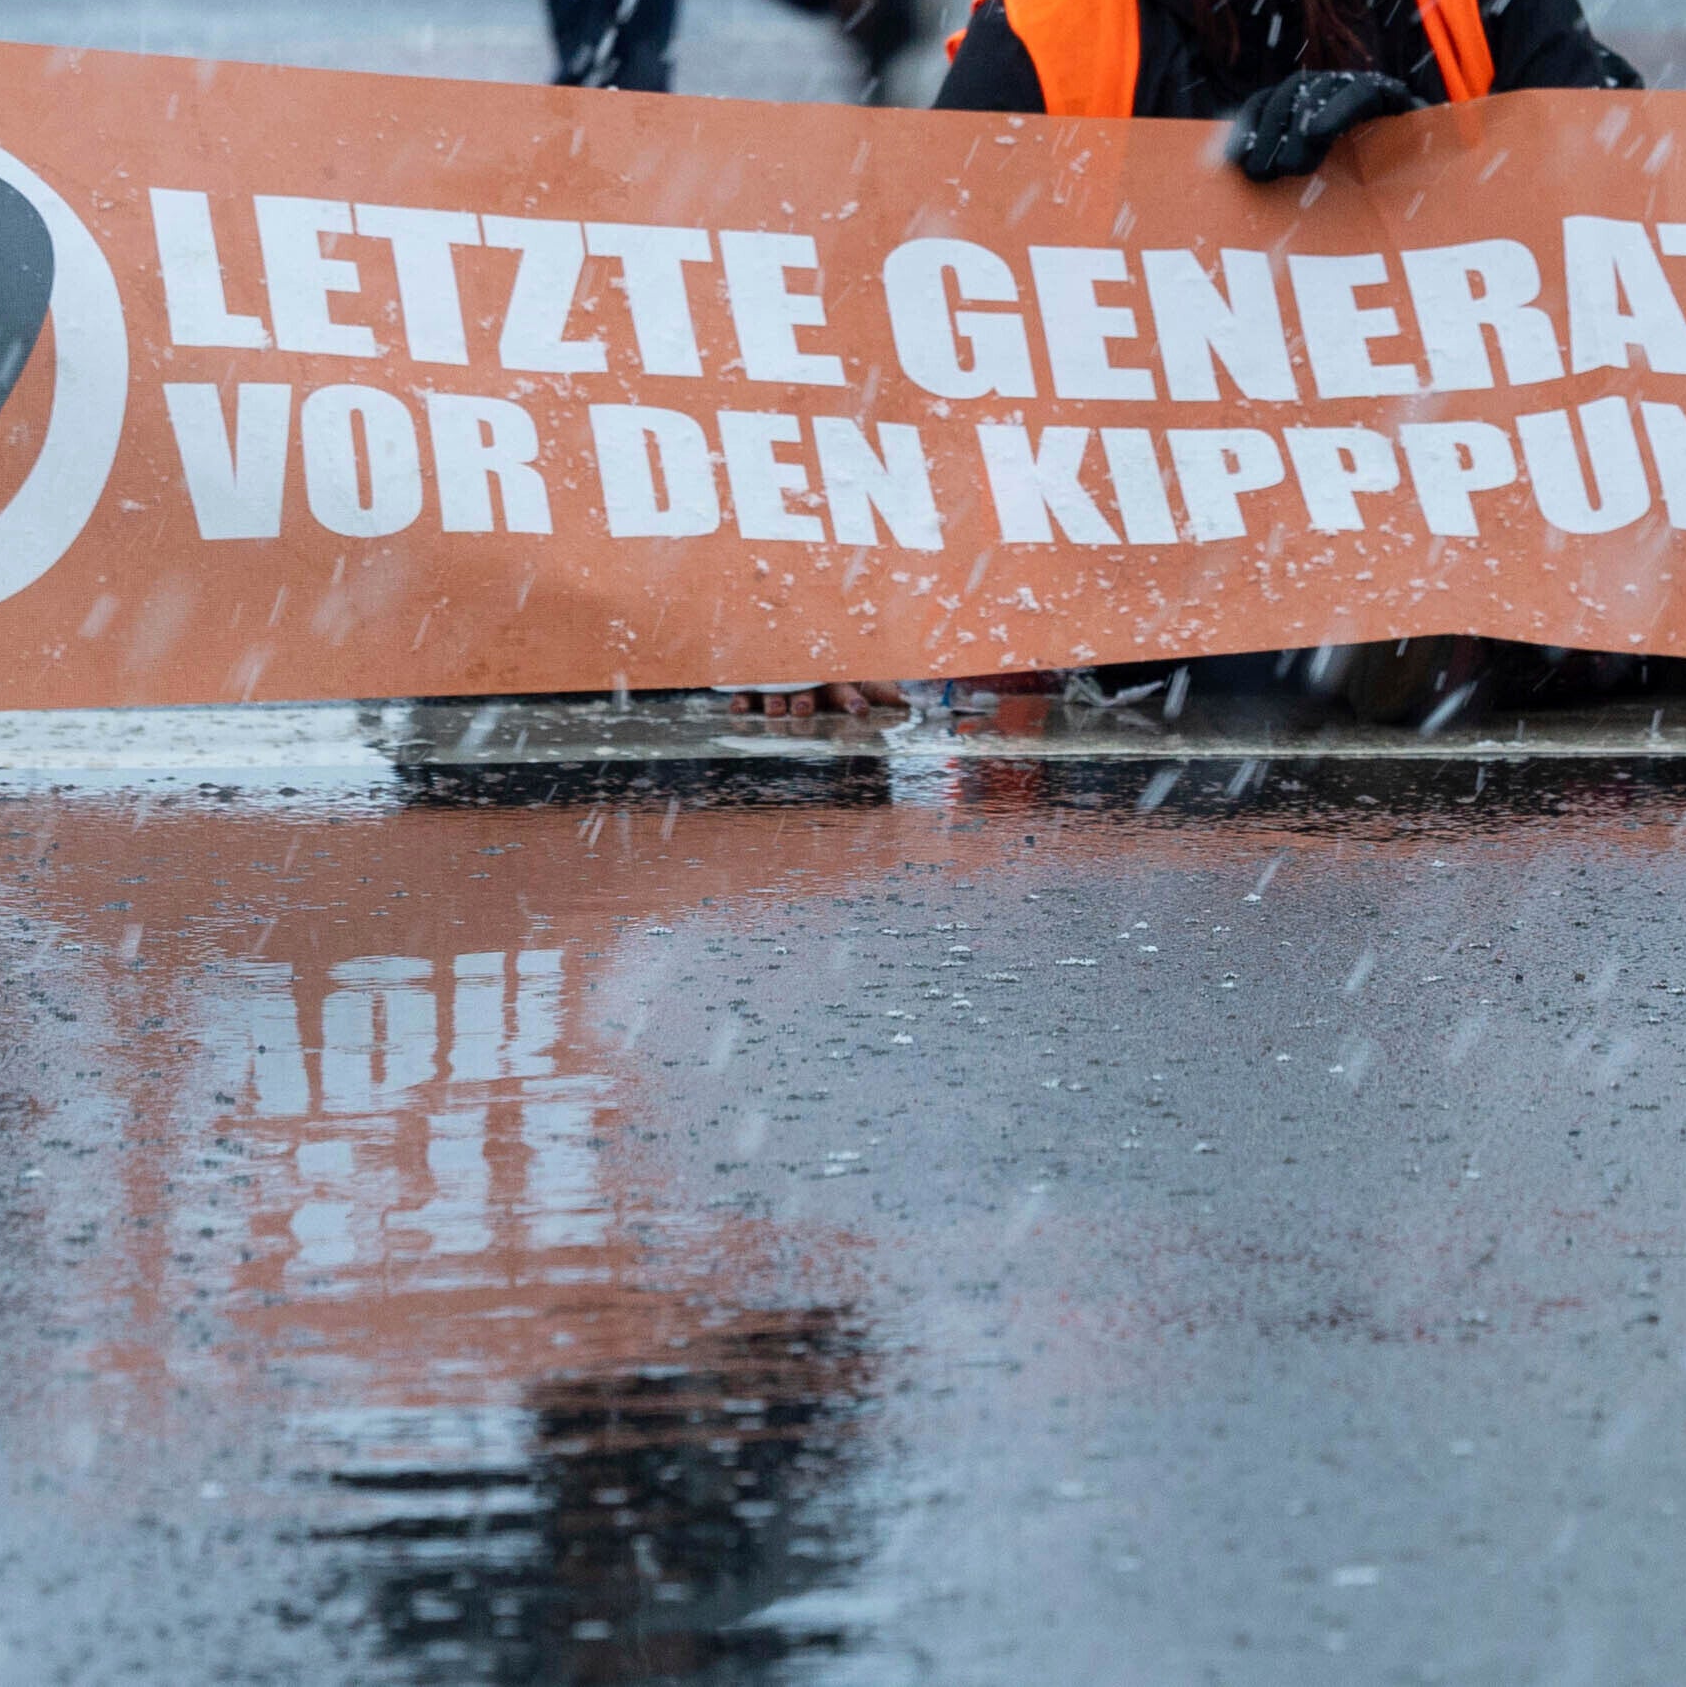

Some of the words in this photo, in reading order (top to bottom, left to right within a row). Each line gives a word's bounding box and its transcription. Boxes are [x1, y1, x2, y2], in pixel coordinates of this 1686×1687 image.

[148, 187, 846, 386] LETZTE
[162, 382, 553, 541] VOR
[588, 403, 945, 551] DEN
